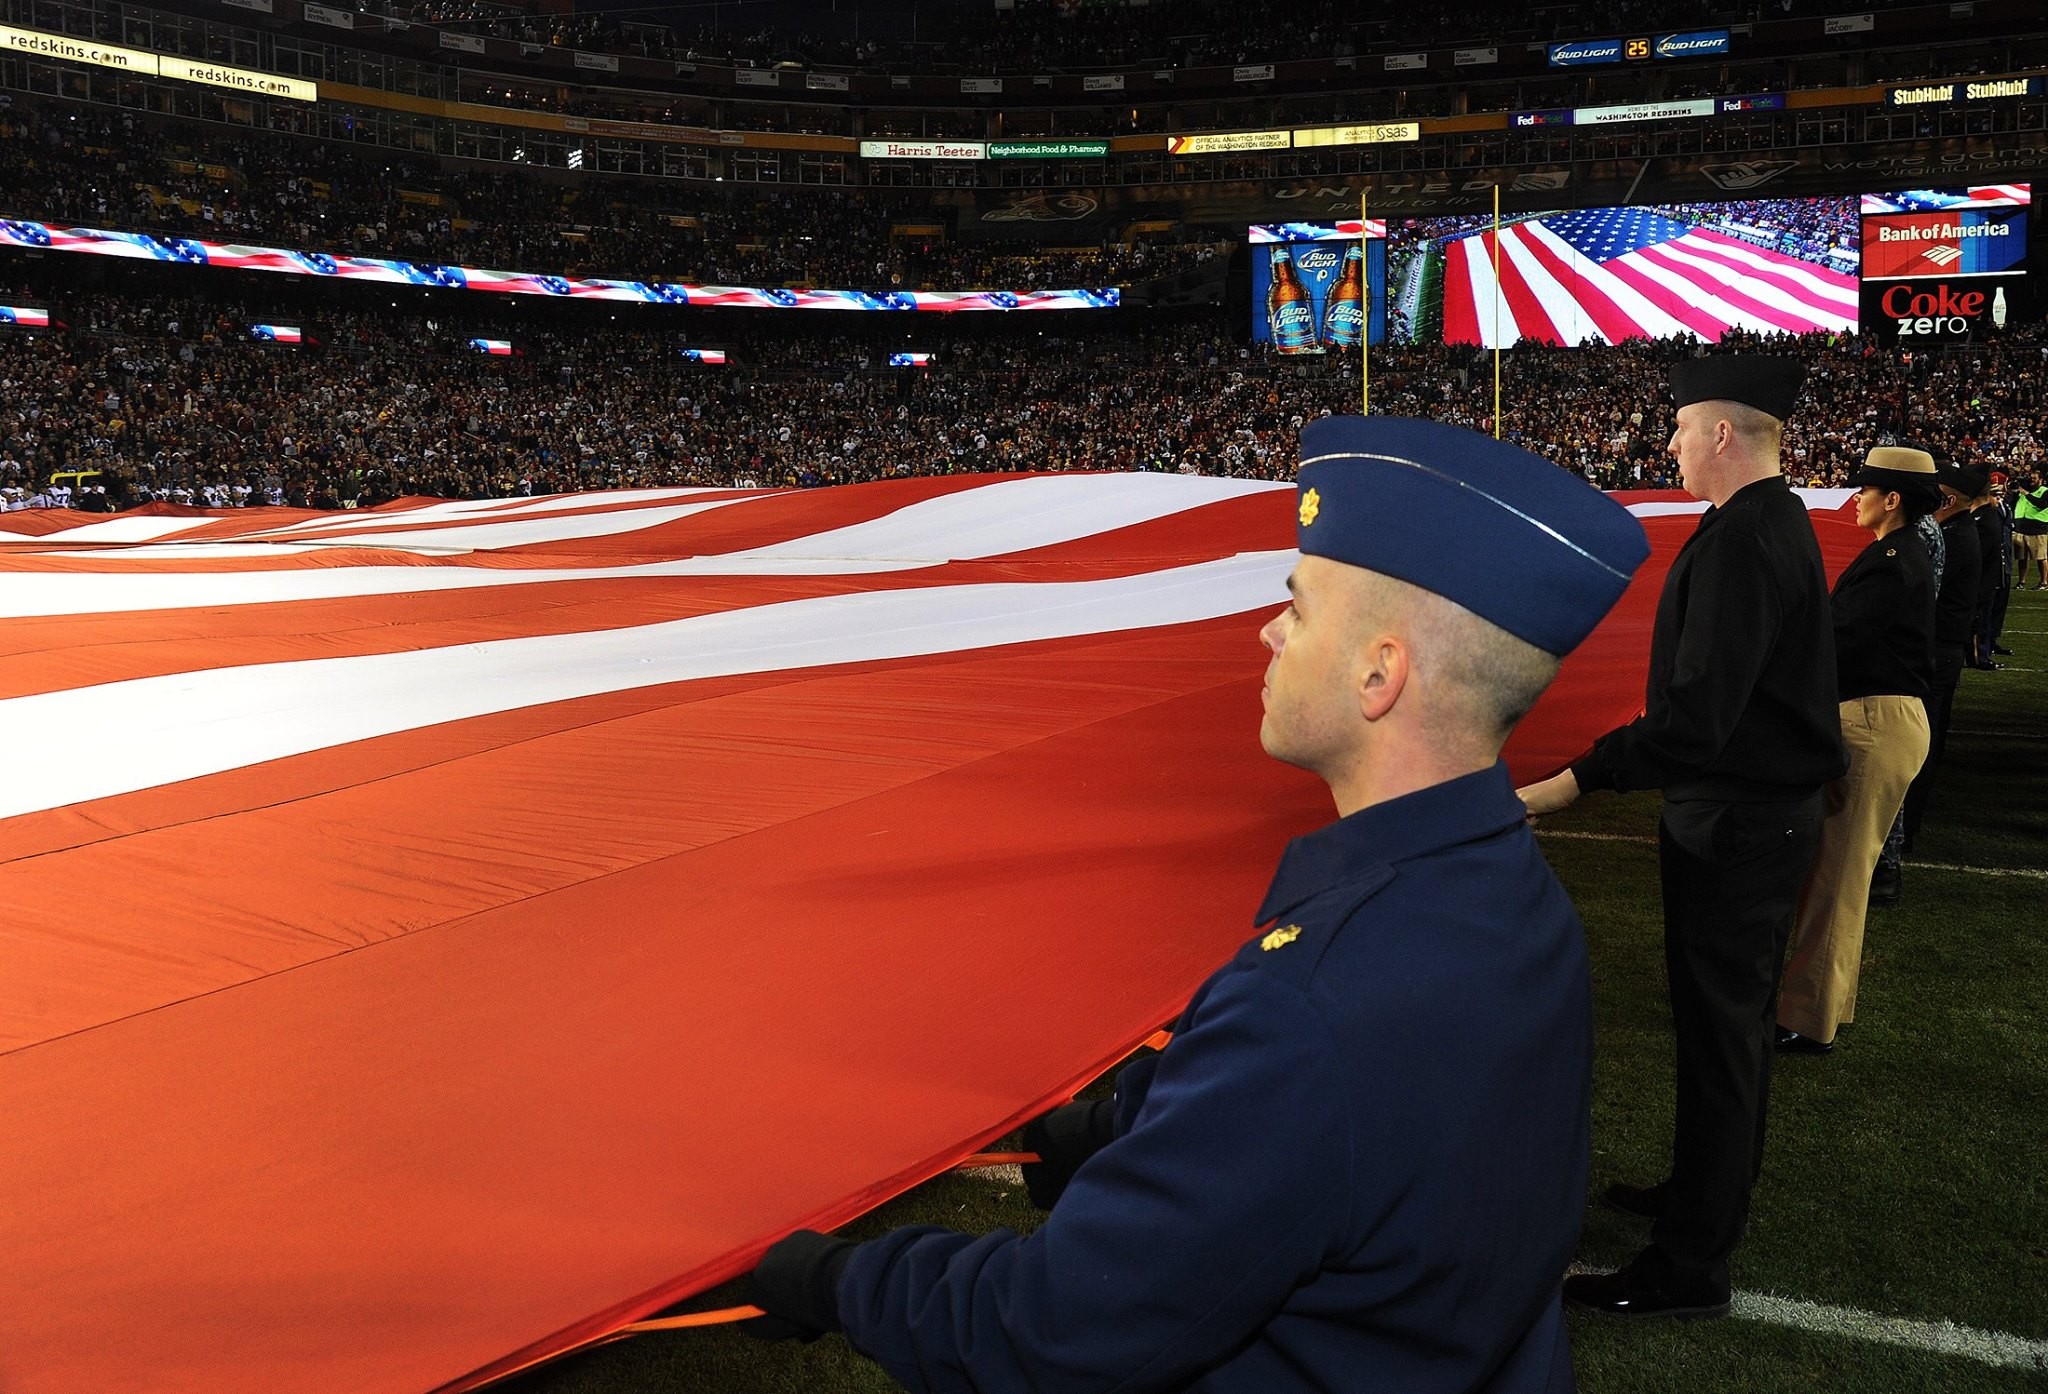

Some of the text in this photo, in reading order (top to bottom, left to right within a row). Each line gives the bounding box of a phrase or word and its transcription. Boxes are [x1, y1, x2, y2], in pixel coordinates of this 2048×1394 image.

[1628, 41, 1647, 56] 25
[1663, 38, 1725, 50] BUD LIGHT
[1557, 47, 1618, 59] BUD LIGHT
[1894, 85, 1954, 105] StubHub!
[1966, 79, 2028, 100] StubHub!
[1595, 108, 1692, 121] WASHINGTON REDSKINS
[1195, 133, 1281, 144] OFFICIAL ANALYTICS PARTNER
[1218, 141, 1258, 150] WASHINGTON
[1259, 139, 1288, 148] REDSKINS
[888, 144, 980, 157] Harris Teeter
[991, 144, 1107, 155] Neighborhood Food & Pharmacy
[1274, 180, 1498, 199] UNITED
[1879, 222, 2009, 241] Bank of America
[1310, 252, 1337, 261] BUD
[1304, 259, 1340, 268] LIGHT
[1881, 285, 1985, 318] Coke
[1280, 307, 1308, 319] BUD
[1335, 304, 1364, 318] BUD
[1276, 315, 1311, 329] LIGHT
[56, 493, 70, 504] 77
